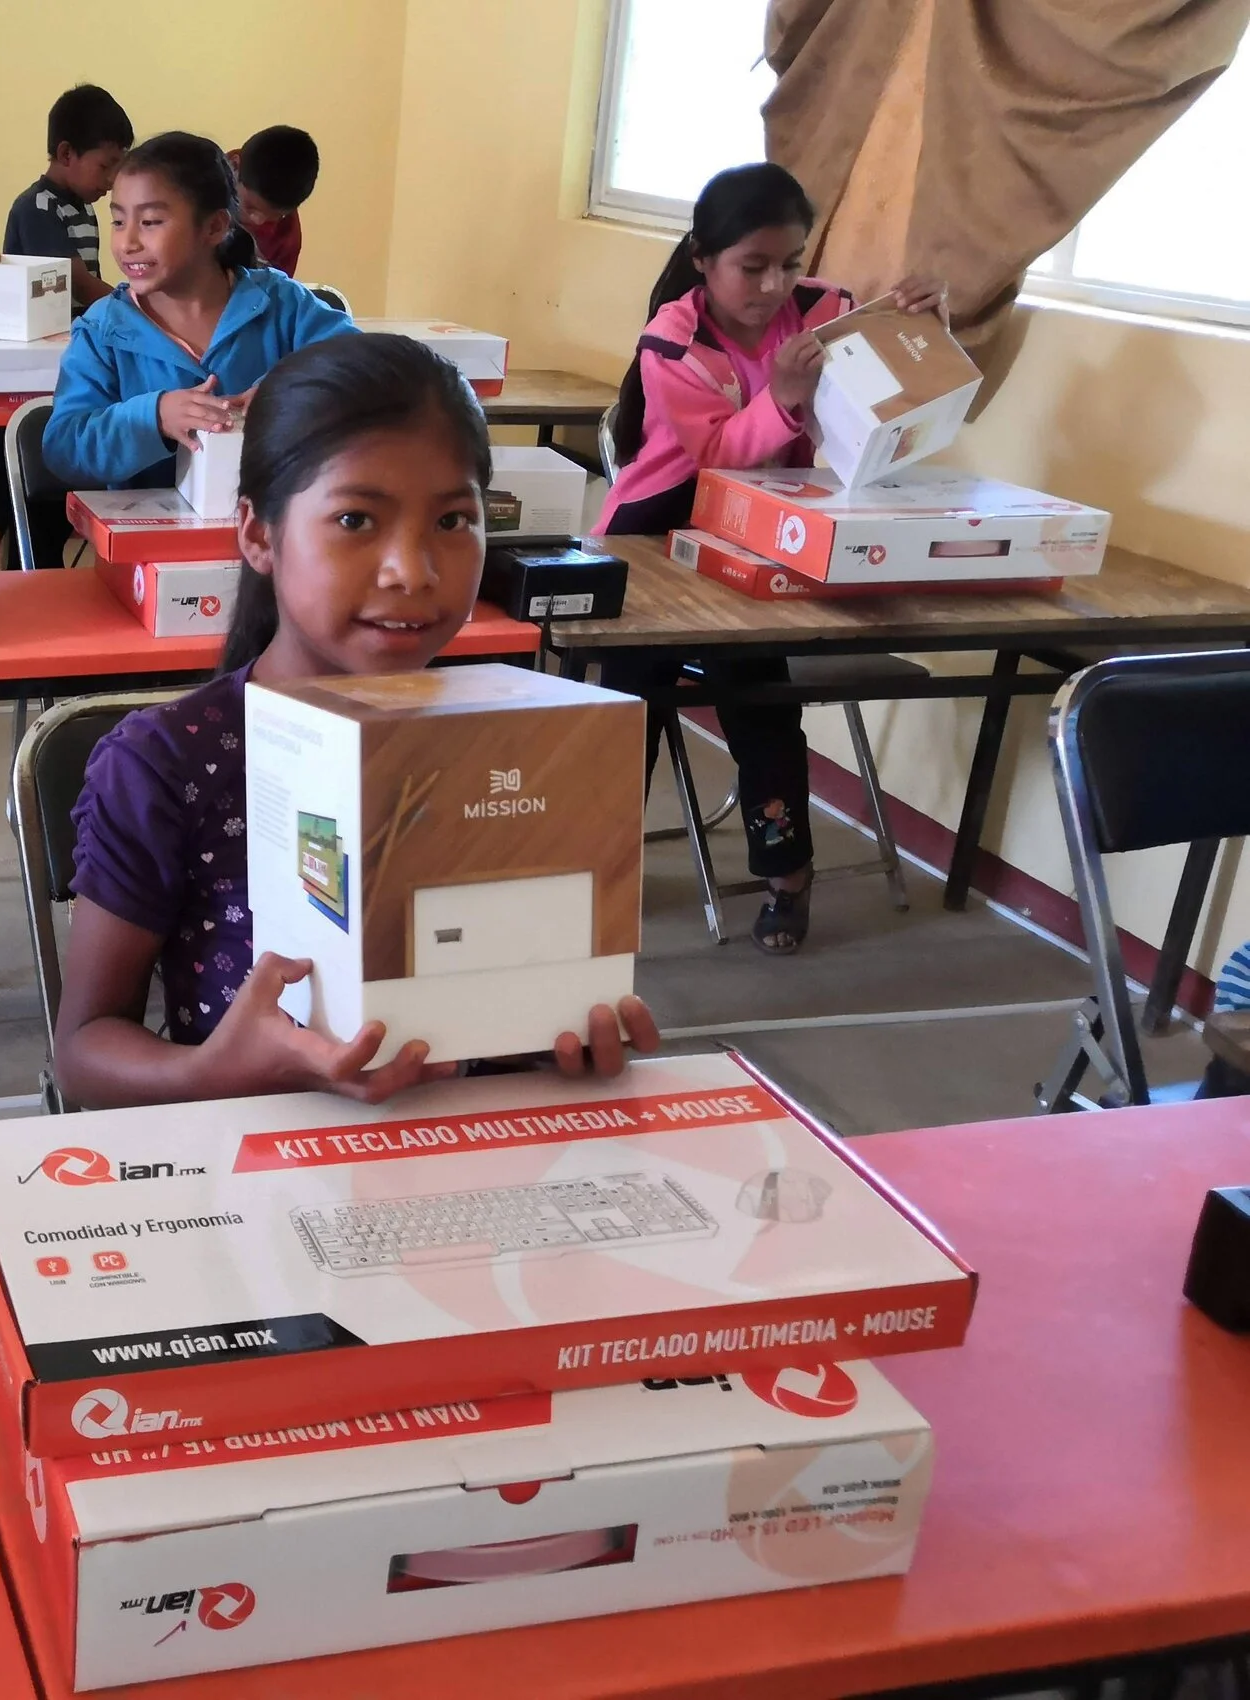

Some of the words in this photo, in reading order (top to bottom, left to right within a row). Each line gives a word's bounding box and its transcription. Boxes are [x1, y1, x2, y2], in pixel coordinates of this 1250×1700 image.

[274, 1136, 322, 1161] KIT
[327, 1124, 454, 1158] TECLADO
[460, 1108, 636, 1144] MULTIMEDIA
[640, 1111, 656, 1124] +
[659, 1094, 760, 1123] MOUSE
[23, 1222, 128, 1245] Comodidad
[130, 1222, 142, 1238] y
[144, 1211, 244, 1234] Ergonomía
[98, 1254, 120, 1268] PC
[89, 1281, 107, 1289] CON
[108, 1278, 146, 1287] WINDOWS
[90, 1272, 140, 1283] COMPATIBLE
[91, 1328, 278, 1365] www.qian.mx
[556, 1343, 594, 1370] KIT
[600, 1333, 698, 1364] TECLADO
[703, 1317, 837, 1353] MULTIMEDIA
[843, 1320, 857, 1336] +
[861, 1306, 938, 1337] MOUSE
[784, 1516, 822, 1533] LED
